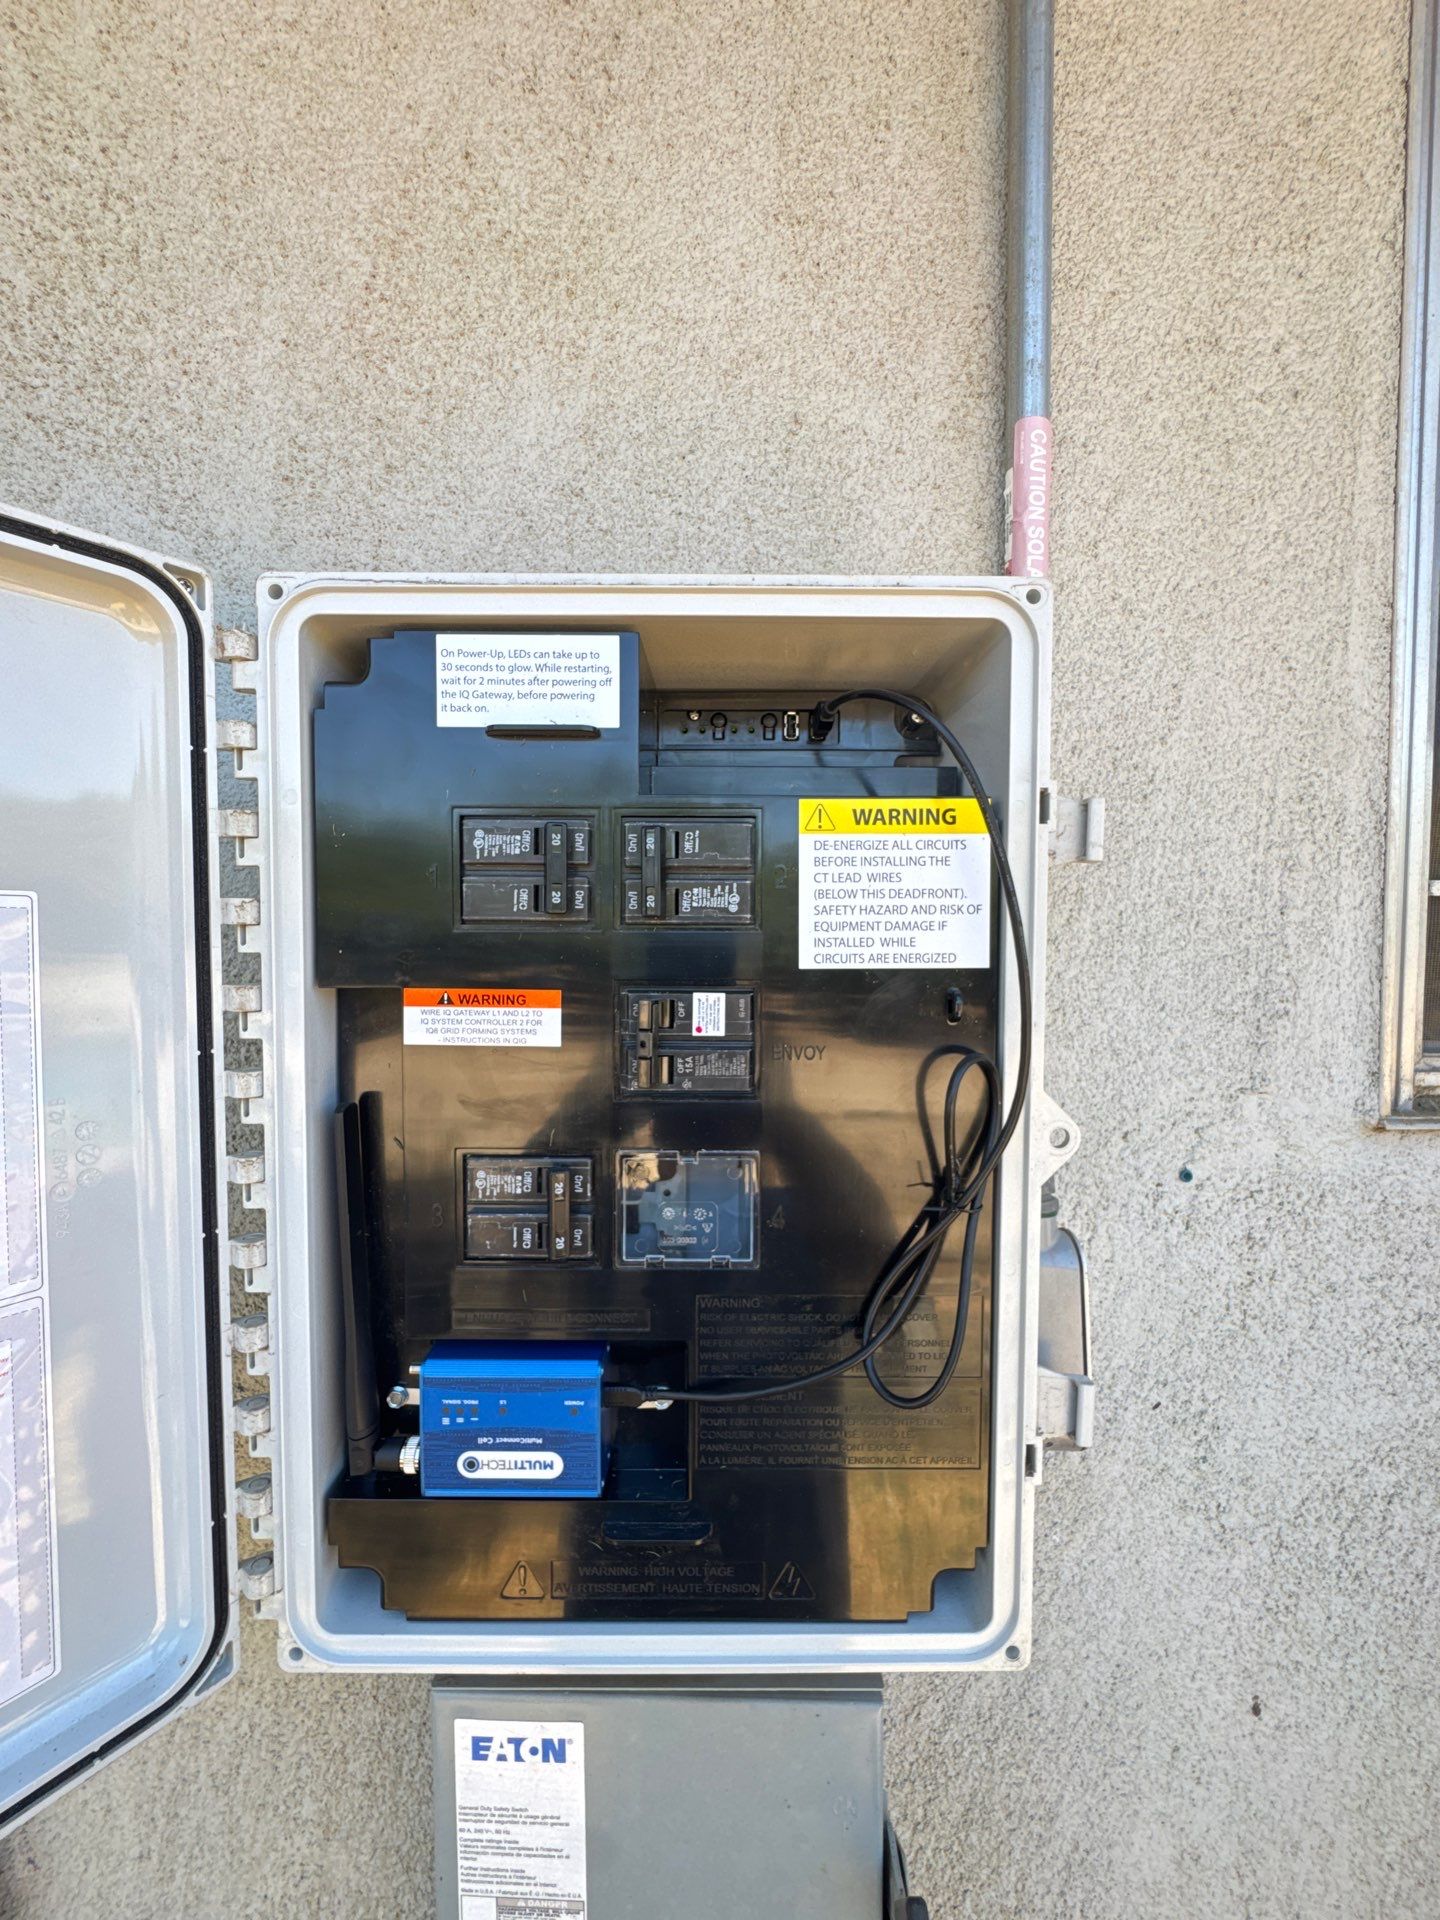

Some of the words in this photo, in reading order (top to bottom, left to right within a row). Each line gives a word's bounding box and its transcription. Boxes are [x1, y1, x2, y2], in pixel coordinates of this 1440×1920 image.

[1028, 428, 1047, 521] CAUTION
[440, 649, 454, 658] On
[457, 648, 506, 660] Power-Up,
[508, 650, 531, 659] LEDs
[552, 651, 573, 660] take
[574, 652, 588, 662] up
[589, 652, 600, 660] to
[440, 663, 452, 672] 30
[455, 663, 493, 672] seconds
[495, 664, 506, 673] to
[507, 663, 534, 676] glow.
[534, 663, 562, 673] While
[563, 664, 613, 676] restarting,
[441, 676, 461, 686] wait
[463, 676, 477, 686] for
[478, 677, 485, 686] 2
[487, 677, 525, 687] minutes
[527, 676, 550, 687] after
[551, 677, 597, 689] powering
[599, 677, 613, 687] off
[441, 690, 457, 699] the
[458, 690, 470, 700] IQ
[471, 690, 515, 702] Gateway,
[517, 690, 548, 700] before
[550, 691, 595, 702] powering
[441, 703, 448, 713] it
[450, 703, 472, 713] back
[474, 705, 490, 713] on.
[852, 808, 958, 825] WARNING
[551, 833, 561, 846] 20
[646, 837, 655, 850] 20
[813, 840, 889, 850] DE-ENERGIZE
[891, 840, 913, 850] ALL
[915, 839, 967, 850] CIRCUITS
[813, 856, 857, 867] BEFORE
[860, 856, 926, 867] INSTALLING
[930, 856, 951, 866] THE
[813, 872, 829, 883] CT
[831, 873, 861, 883] LEAD
[867, 872, 902, 883] WIRES
[551, 891, 561, 904] 20
[813, 888, 858, 901] (BELOW
[861, 888, 886, 899] THIS
[888, 888, 967, 901] DEADFRONT).
[646, 895, 655, 907] 20
[813, 905, 856, 915] SAFETY
[859, 905, 908, 915] HAZARD
[911, 904, 937, 915] AND
[940, 904, 964, 915] RISK
[966, 904, 983, 915] OF
[813, 921, 882, 933] EQUIPMENT
[884, 921, 935, 931] DAMAGE
[938, 921, 948, 931] IF
[813, 937, 875, 948] INSTALLED
[880, 937, 916, 948] WHILE
[813, 953, 865, 964] CIRCUITS
[867, 953, 890, 964] ARE
[893, 953, 957, 964] ENERGIZED
[458, 994, 527, 1006] WARNING
[453, 1009, 490, 1017] GATEWAY
[677, 1001, 686, 1017] OFF
[420, 1018, 429, 1026] IQ
[464, 1018, 518, 1026] CONTROLLER
[440, 1027, 460, 1035] GRID
[461, 1027, 499, 1035] FORMING
[500, 1028, 537, 1036] SYSTEMS
[442, 1036, 501, 1044] INSTRUCTIONS
[771, 1044, 826, 1061] ENVOY
[677, 1057, 685, 1073] OFF
[685, 1056, 693, 1074] 15A
[555, 1182, 564, 1195] 20
[431, 1203, 443, 1227] 3
[555, 1237, 565, 1249] 20
[699, 1298, 761, 1308] WARNING
[700, 1313, 721, 1321] RISK
[723, 1313, 738, 1321] OF
[825, 1313, 841, 1321] DO
[699, 1326, 715, 1334] NO
[699, 1352, 729, 1360] WHEN
[480, 1460, 554, 1470] MULTITECH
[644, 1566, 675, 1577] HIGH
[676, 1566, 735, 1577] VOLTAGE
[662, 1582, 702, 1594] HAUTE
[704, 1582, 760, 1594] TENSION
[471, 1736, 567, 1763] EATON
